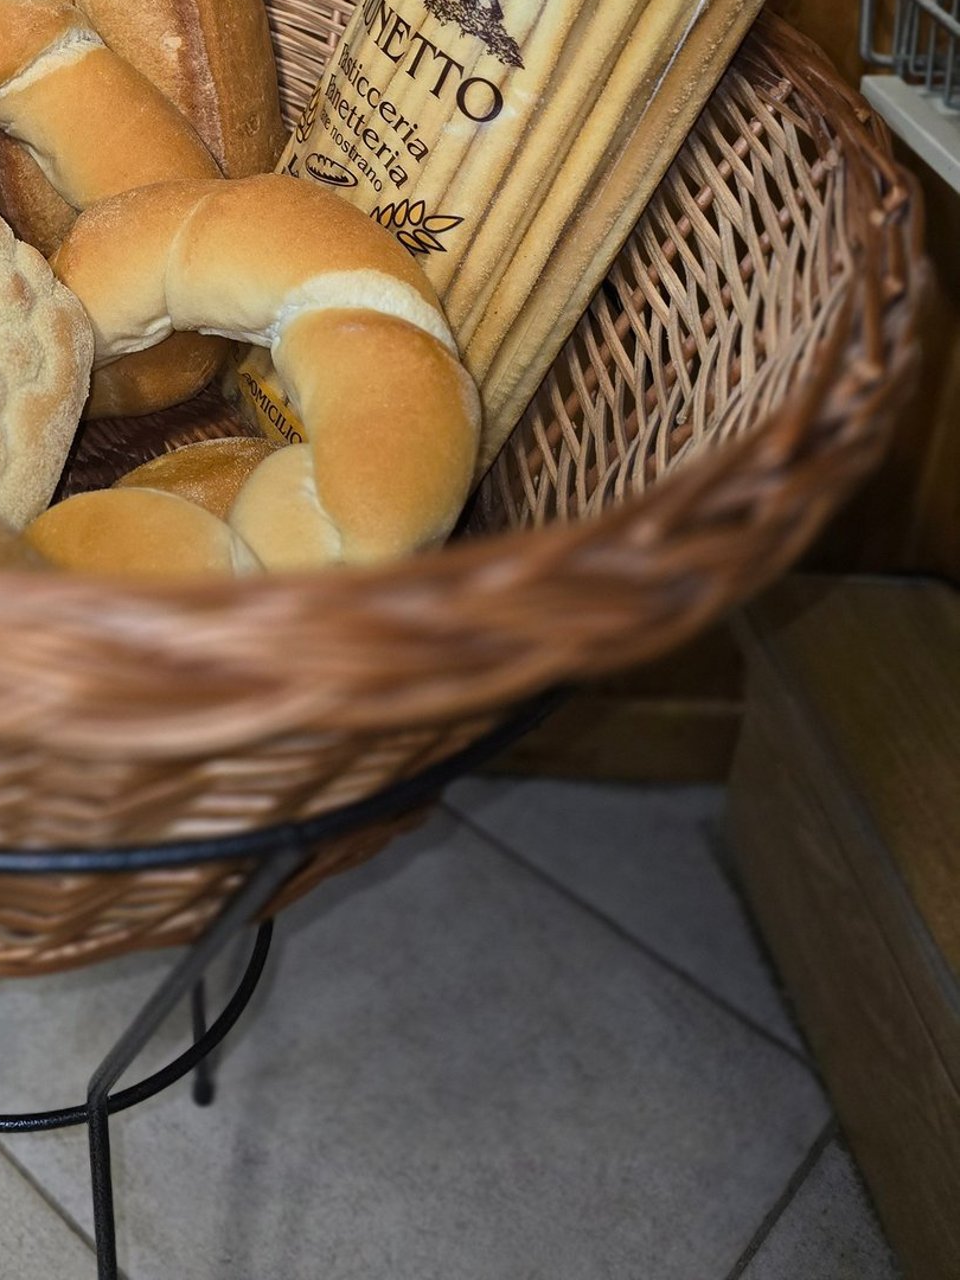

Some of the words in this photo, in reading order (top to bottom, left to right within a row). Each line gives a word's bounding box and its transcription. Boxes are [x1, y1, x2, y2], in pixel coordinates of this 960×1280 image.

[324, 74, 409, 190] Panetteria
[330, 126, 383, 193] nostrano
[338, 43, 429, 163] Pasticceria
